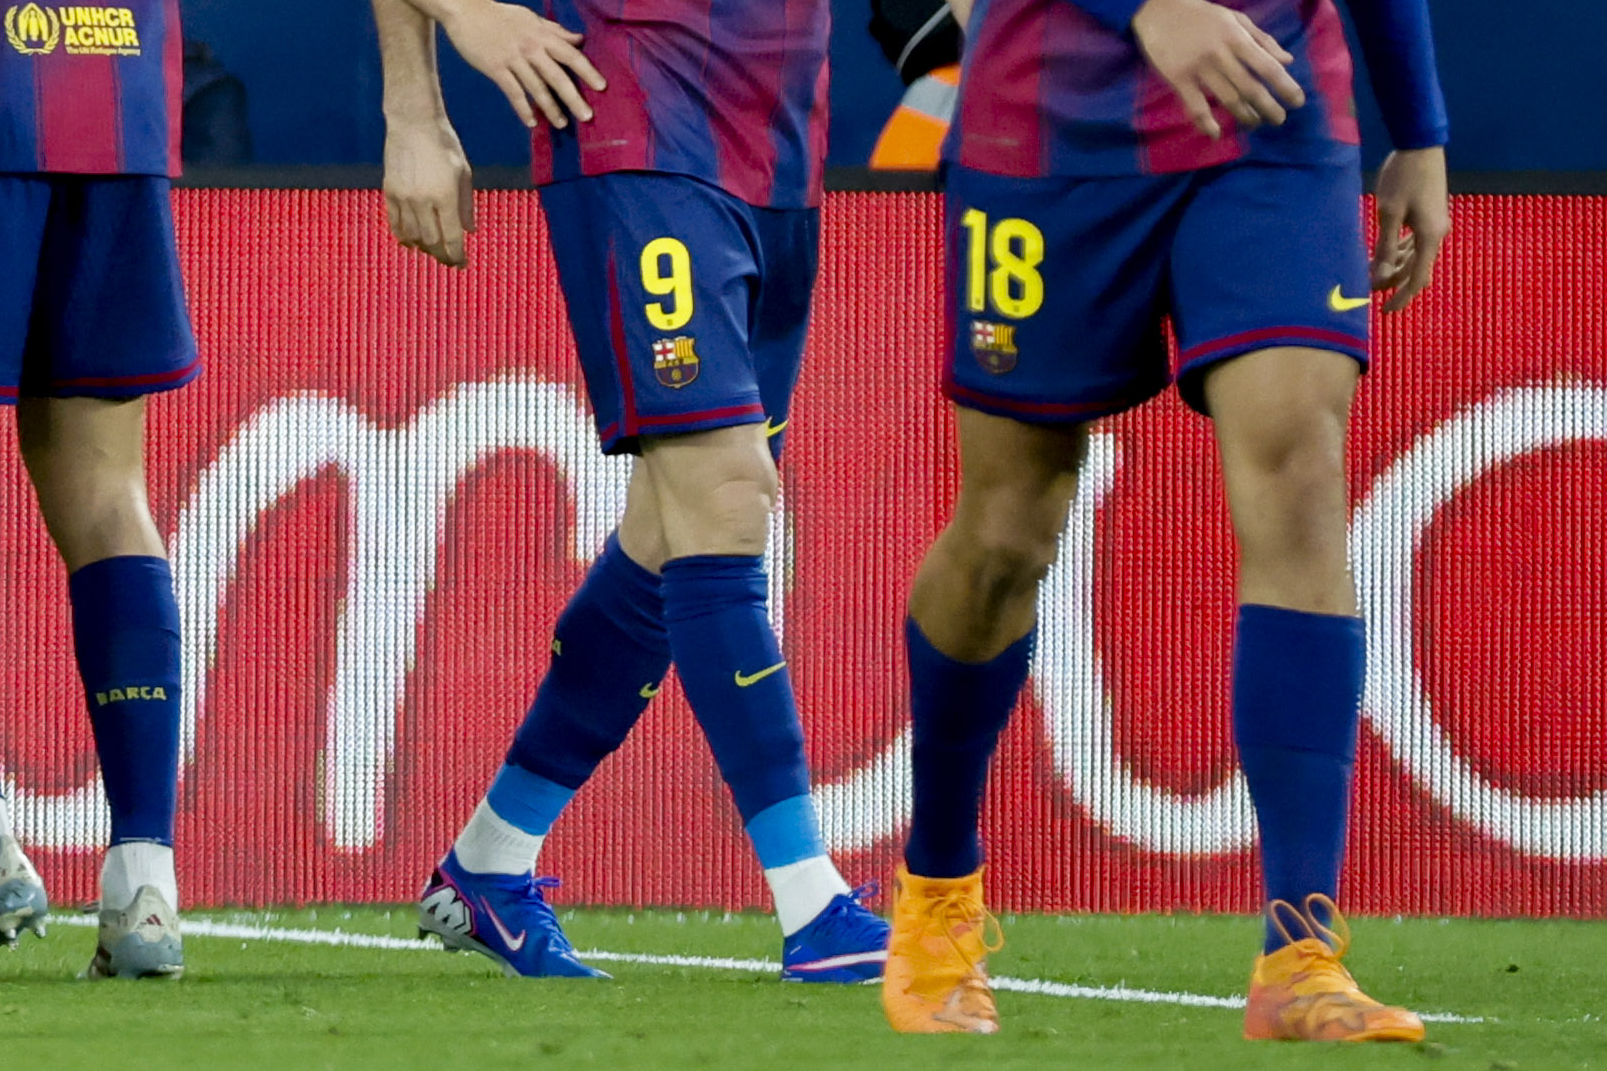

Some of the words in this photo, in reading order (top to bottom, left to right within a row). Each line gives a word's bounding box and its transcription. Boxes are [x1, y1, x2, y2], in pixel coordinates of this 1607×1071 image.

[58, 6, 135, 27] UNHCR
[64, 26, 139, 46] ACNUR
[639, 237, 694, 331] 9
[961, 208, 1045, 319] 18
